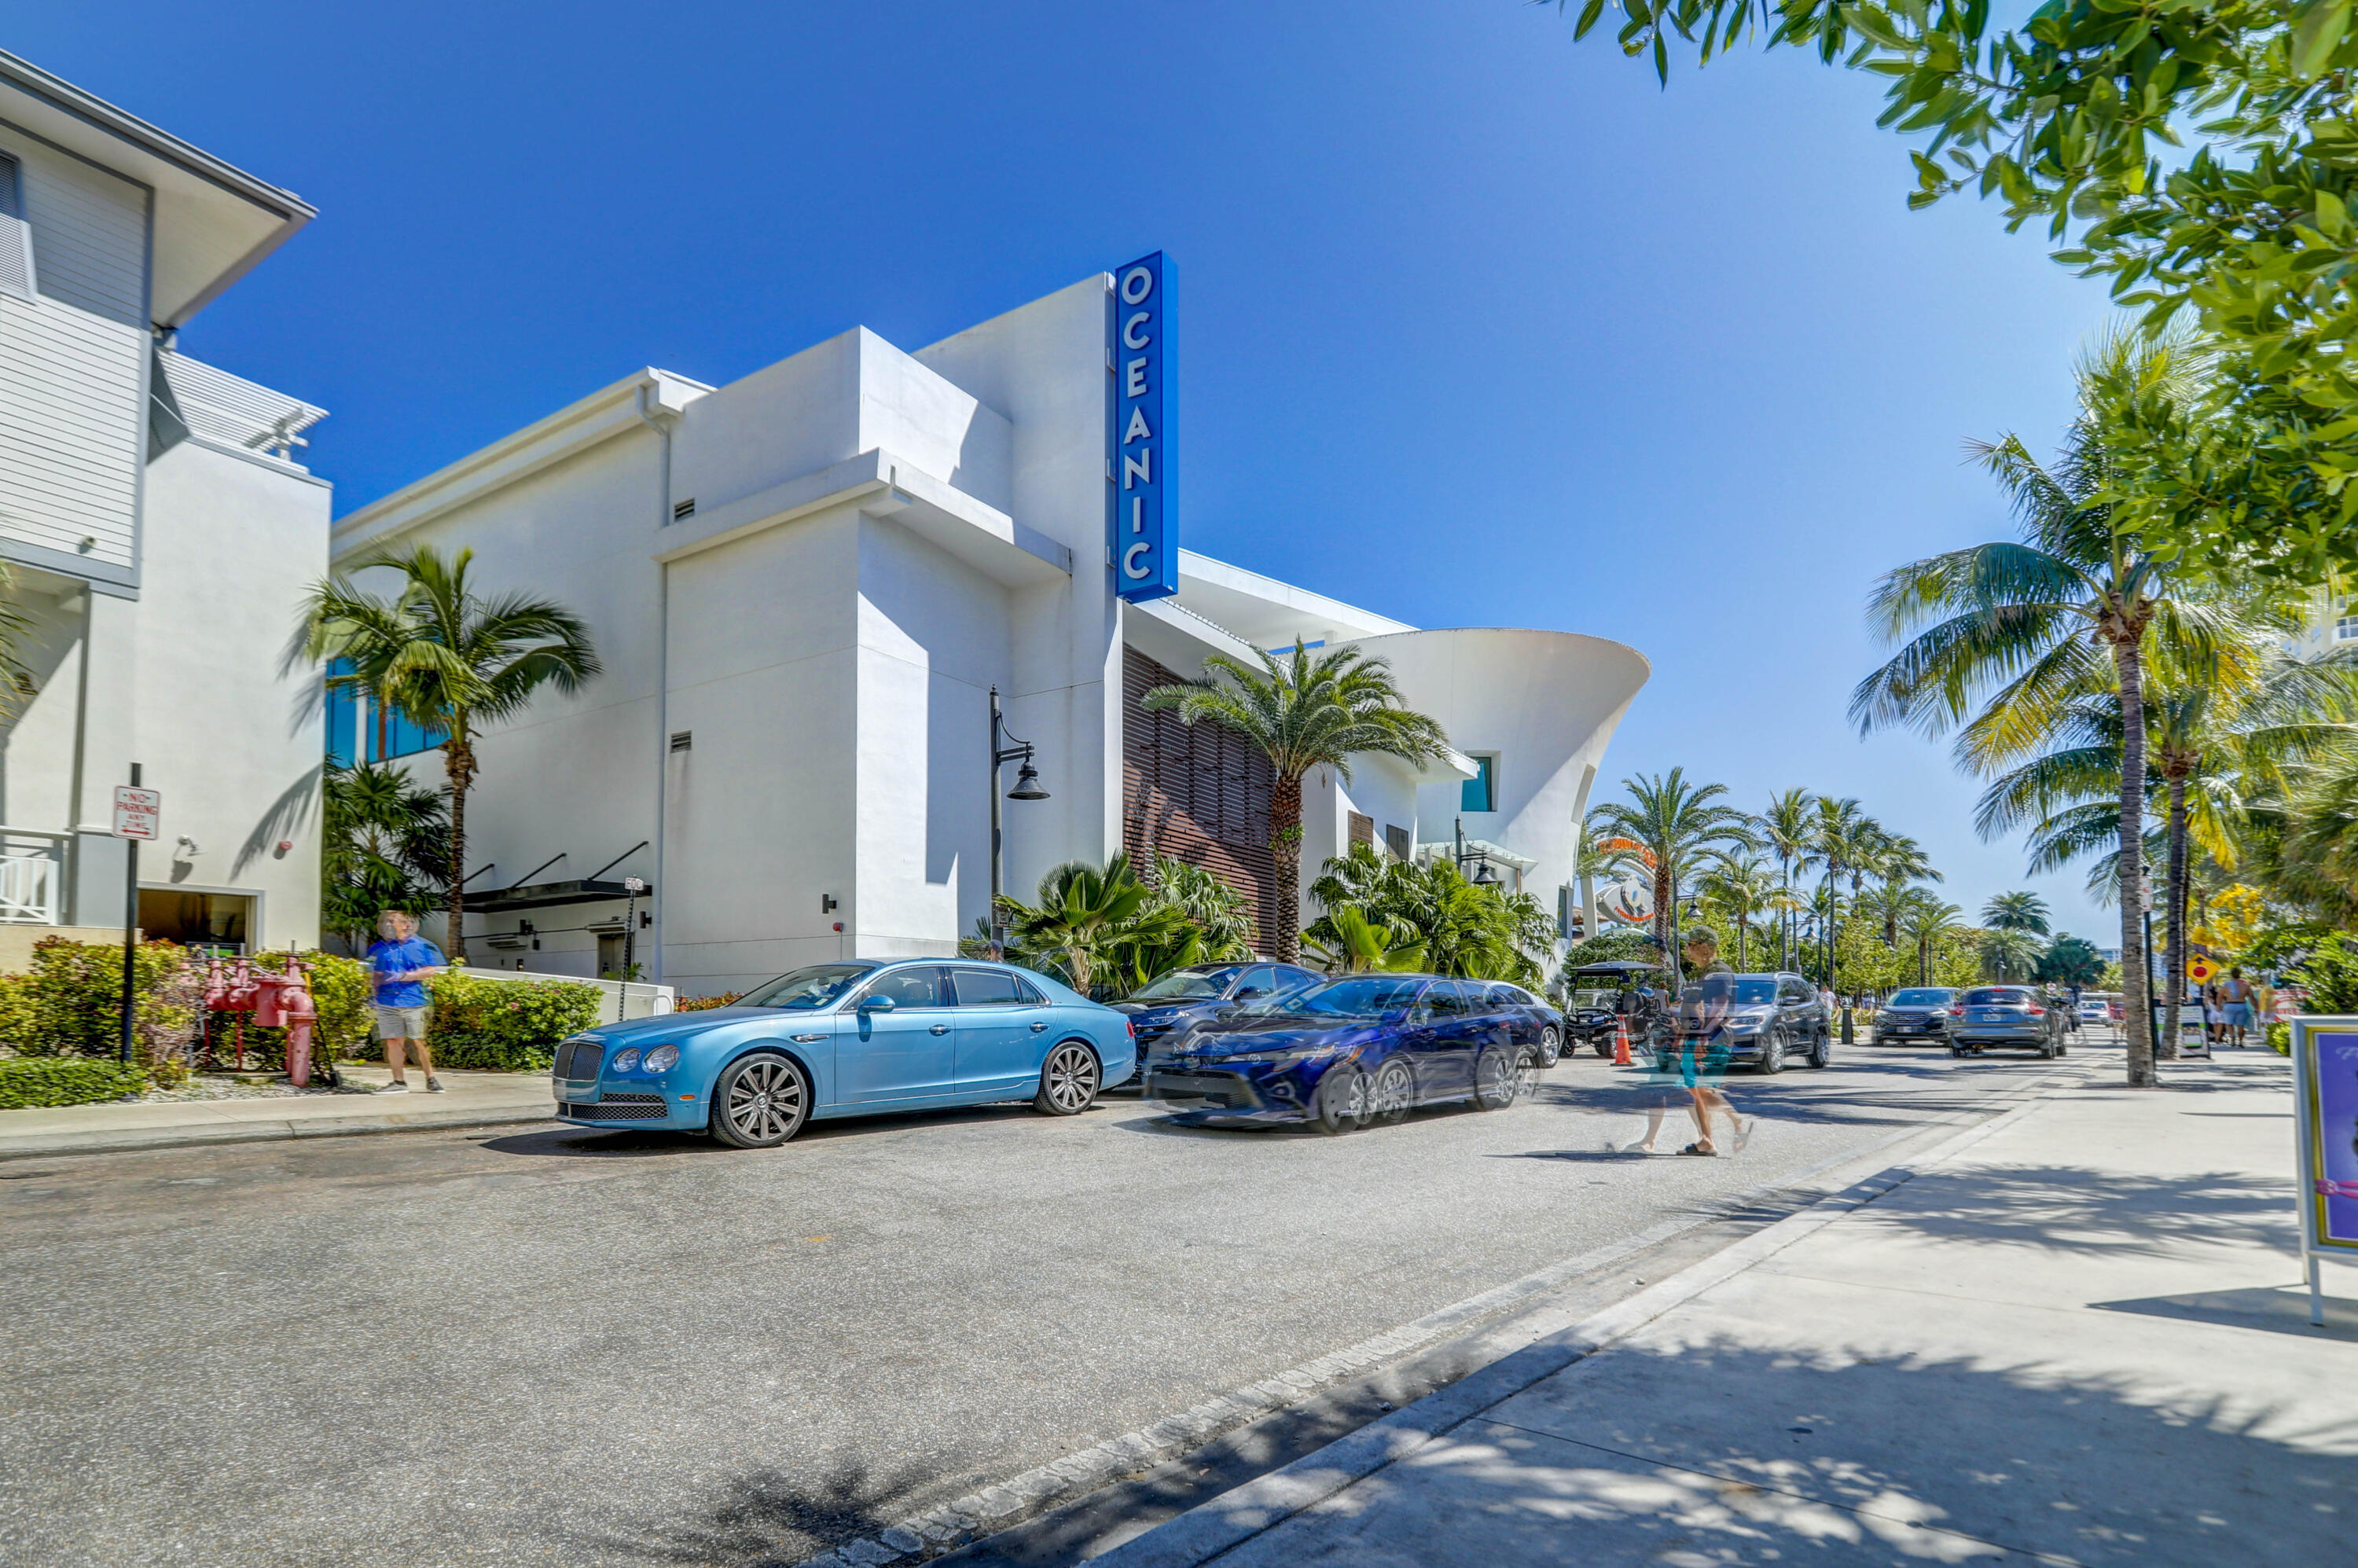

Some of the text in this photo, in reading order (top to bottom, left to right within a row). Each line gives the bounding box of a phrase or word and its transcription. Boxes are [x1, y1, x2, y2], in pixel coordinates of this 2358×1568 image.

[1122, 267, 1152, 580] OCEANIC
[129, 792, 146, 803] NO
[116, 802, 158, 815] PARKING
